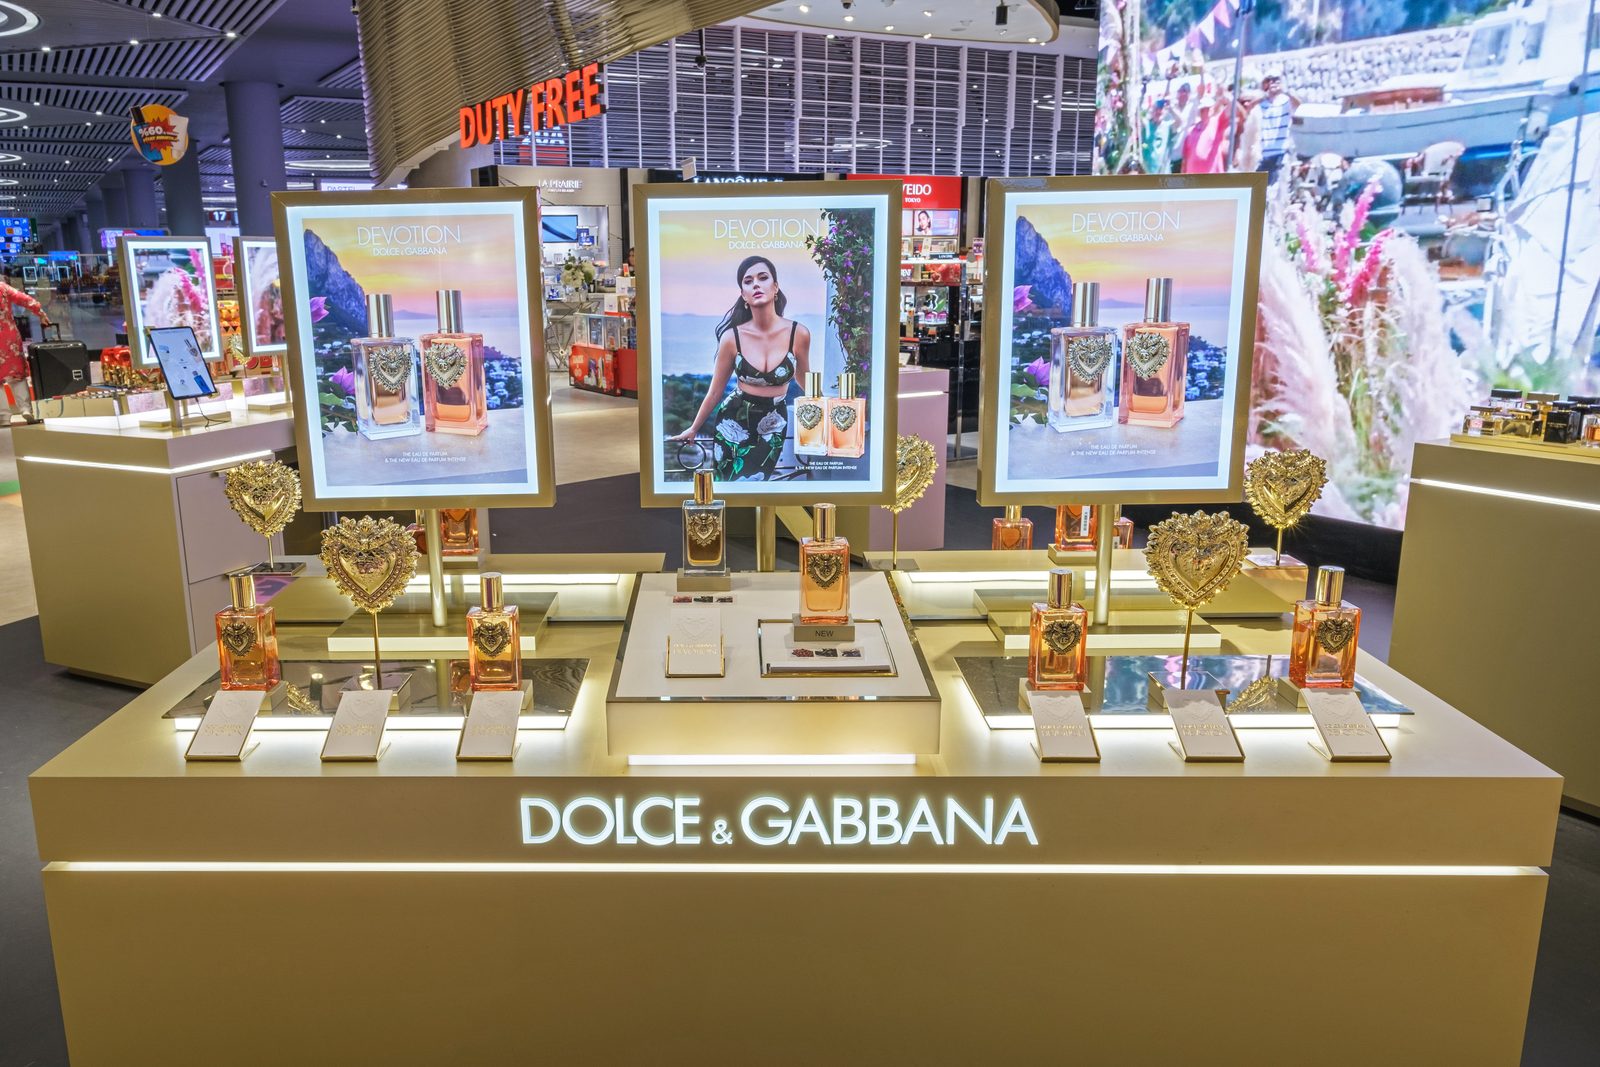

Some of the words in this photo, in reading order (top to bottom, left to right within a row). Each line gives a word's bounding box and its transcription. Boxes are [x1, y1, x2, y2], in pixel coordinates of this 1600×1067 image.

[460, 88, 524, 149] DUTY
[531, 62, 601, 132] FREE
[213, 211, 227, 221] 17
[1072, 210, 1181, 233] DEVOTION
[357, 224, 462, 246] DEVOTION
[714, 218, 820, 239] DEVOTION
[728, 240, 756, 250] DOLCE
[761, 240, 804, 249] GABBANA
[1086, 234, 1114, 243] DOLCE
[1119, 233, 1164, 243] GABBANA
[373, 247, 400, 256] DOLCE
[404, 246, 448, 256] GABBANA
[815, 629, 834, 638] NEW
[520, 797, 701, 846] DOLCE
[711, 819, 733, 845] &
[740, 796, 1039, 847] GABBANA
